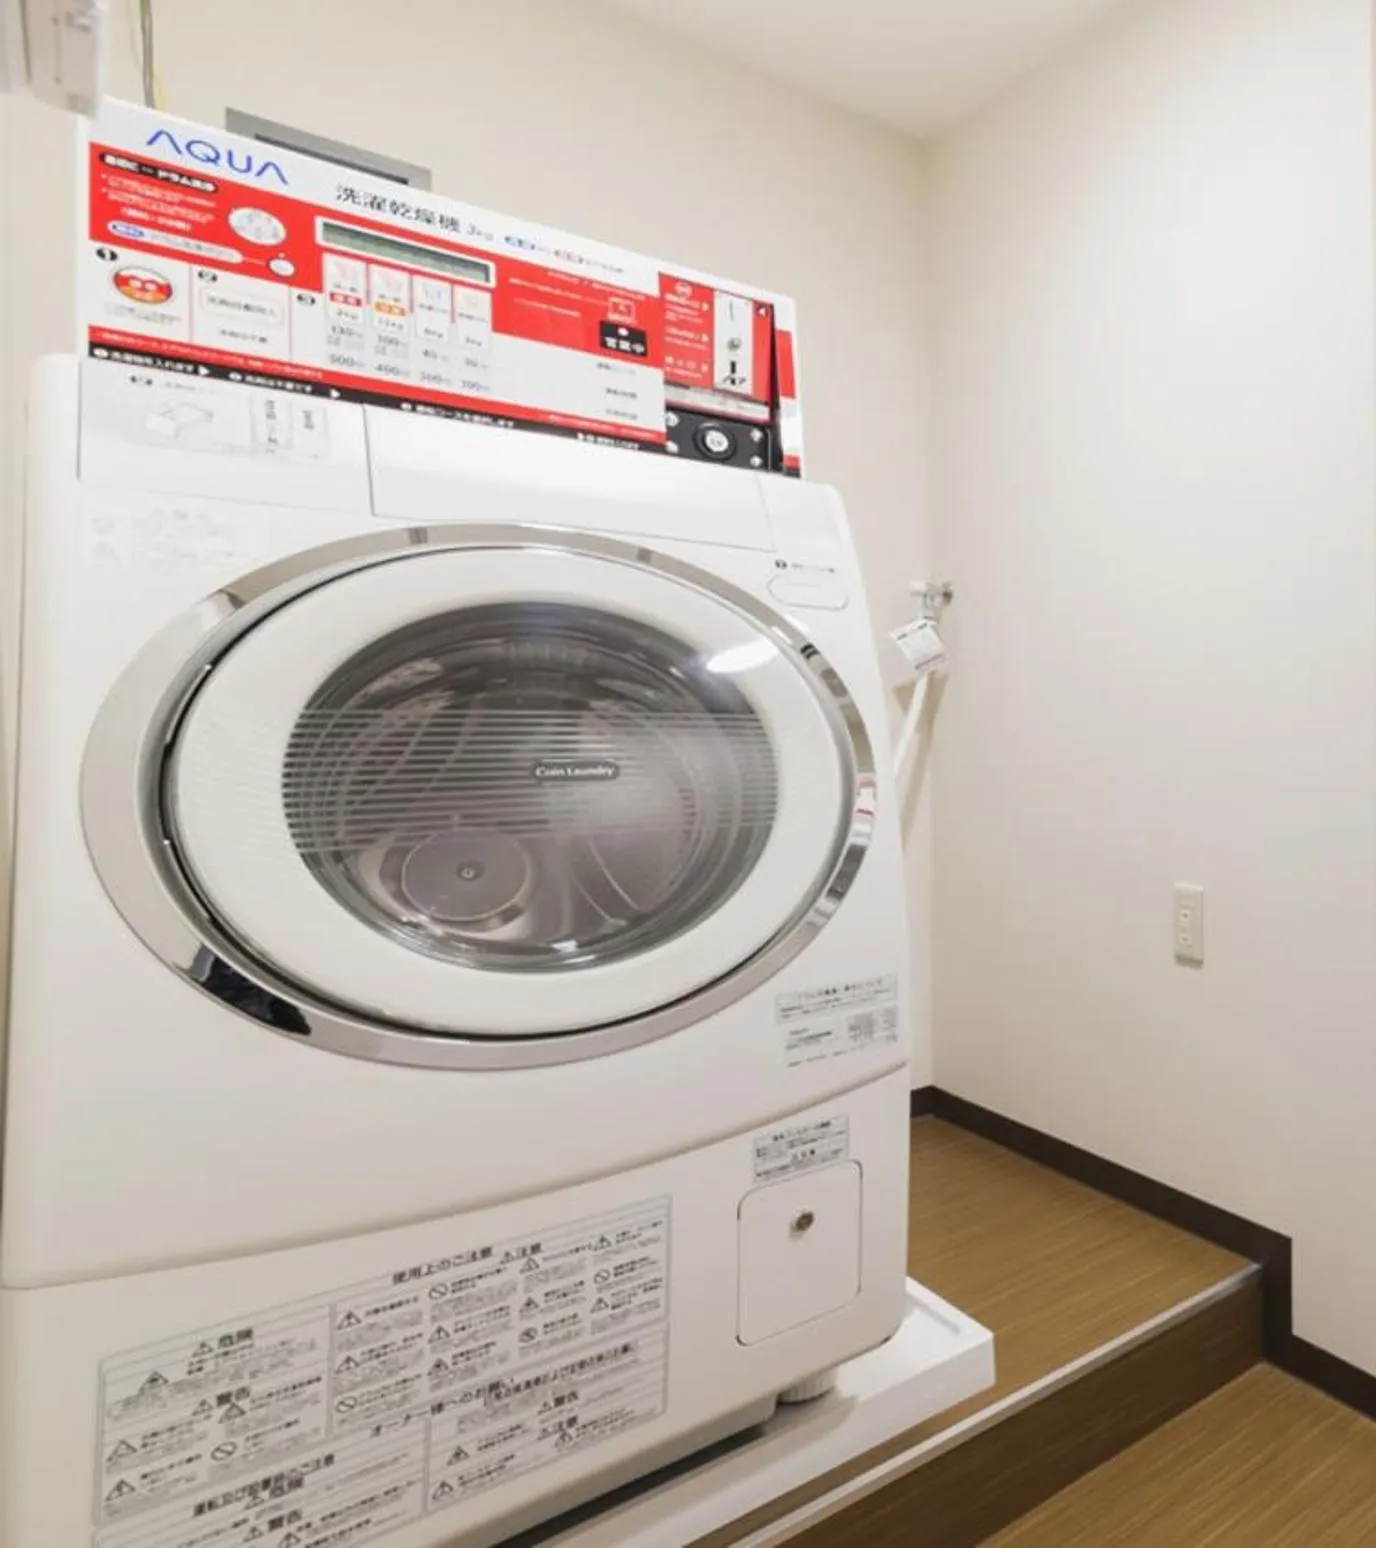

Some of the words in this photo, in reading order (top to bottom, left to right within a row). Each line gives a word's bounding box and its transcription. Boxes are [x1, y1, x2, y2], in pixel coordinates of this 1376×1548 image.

[147, 129, 288, 184] AQUA
[336, 184, 461, 233] 洗濯乾燥機
[392, 1246, 493, 1286] 使用上のご注意
